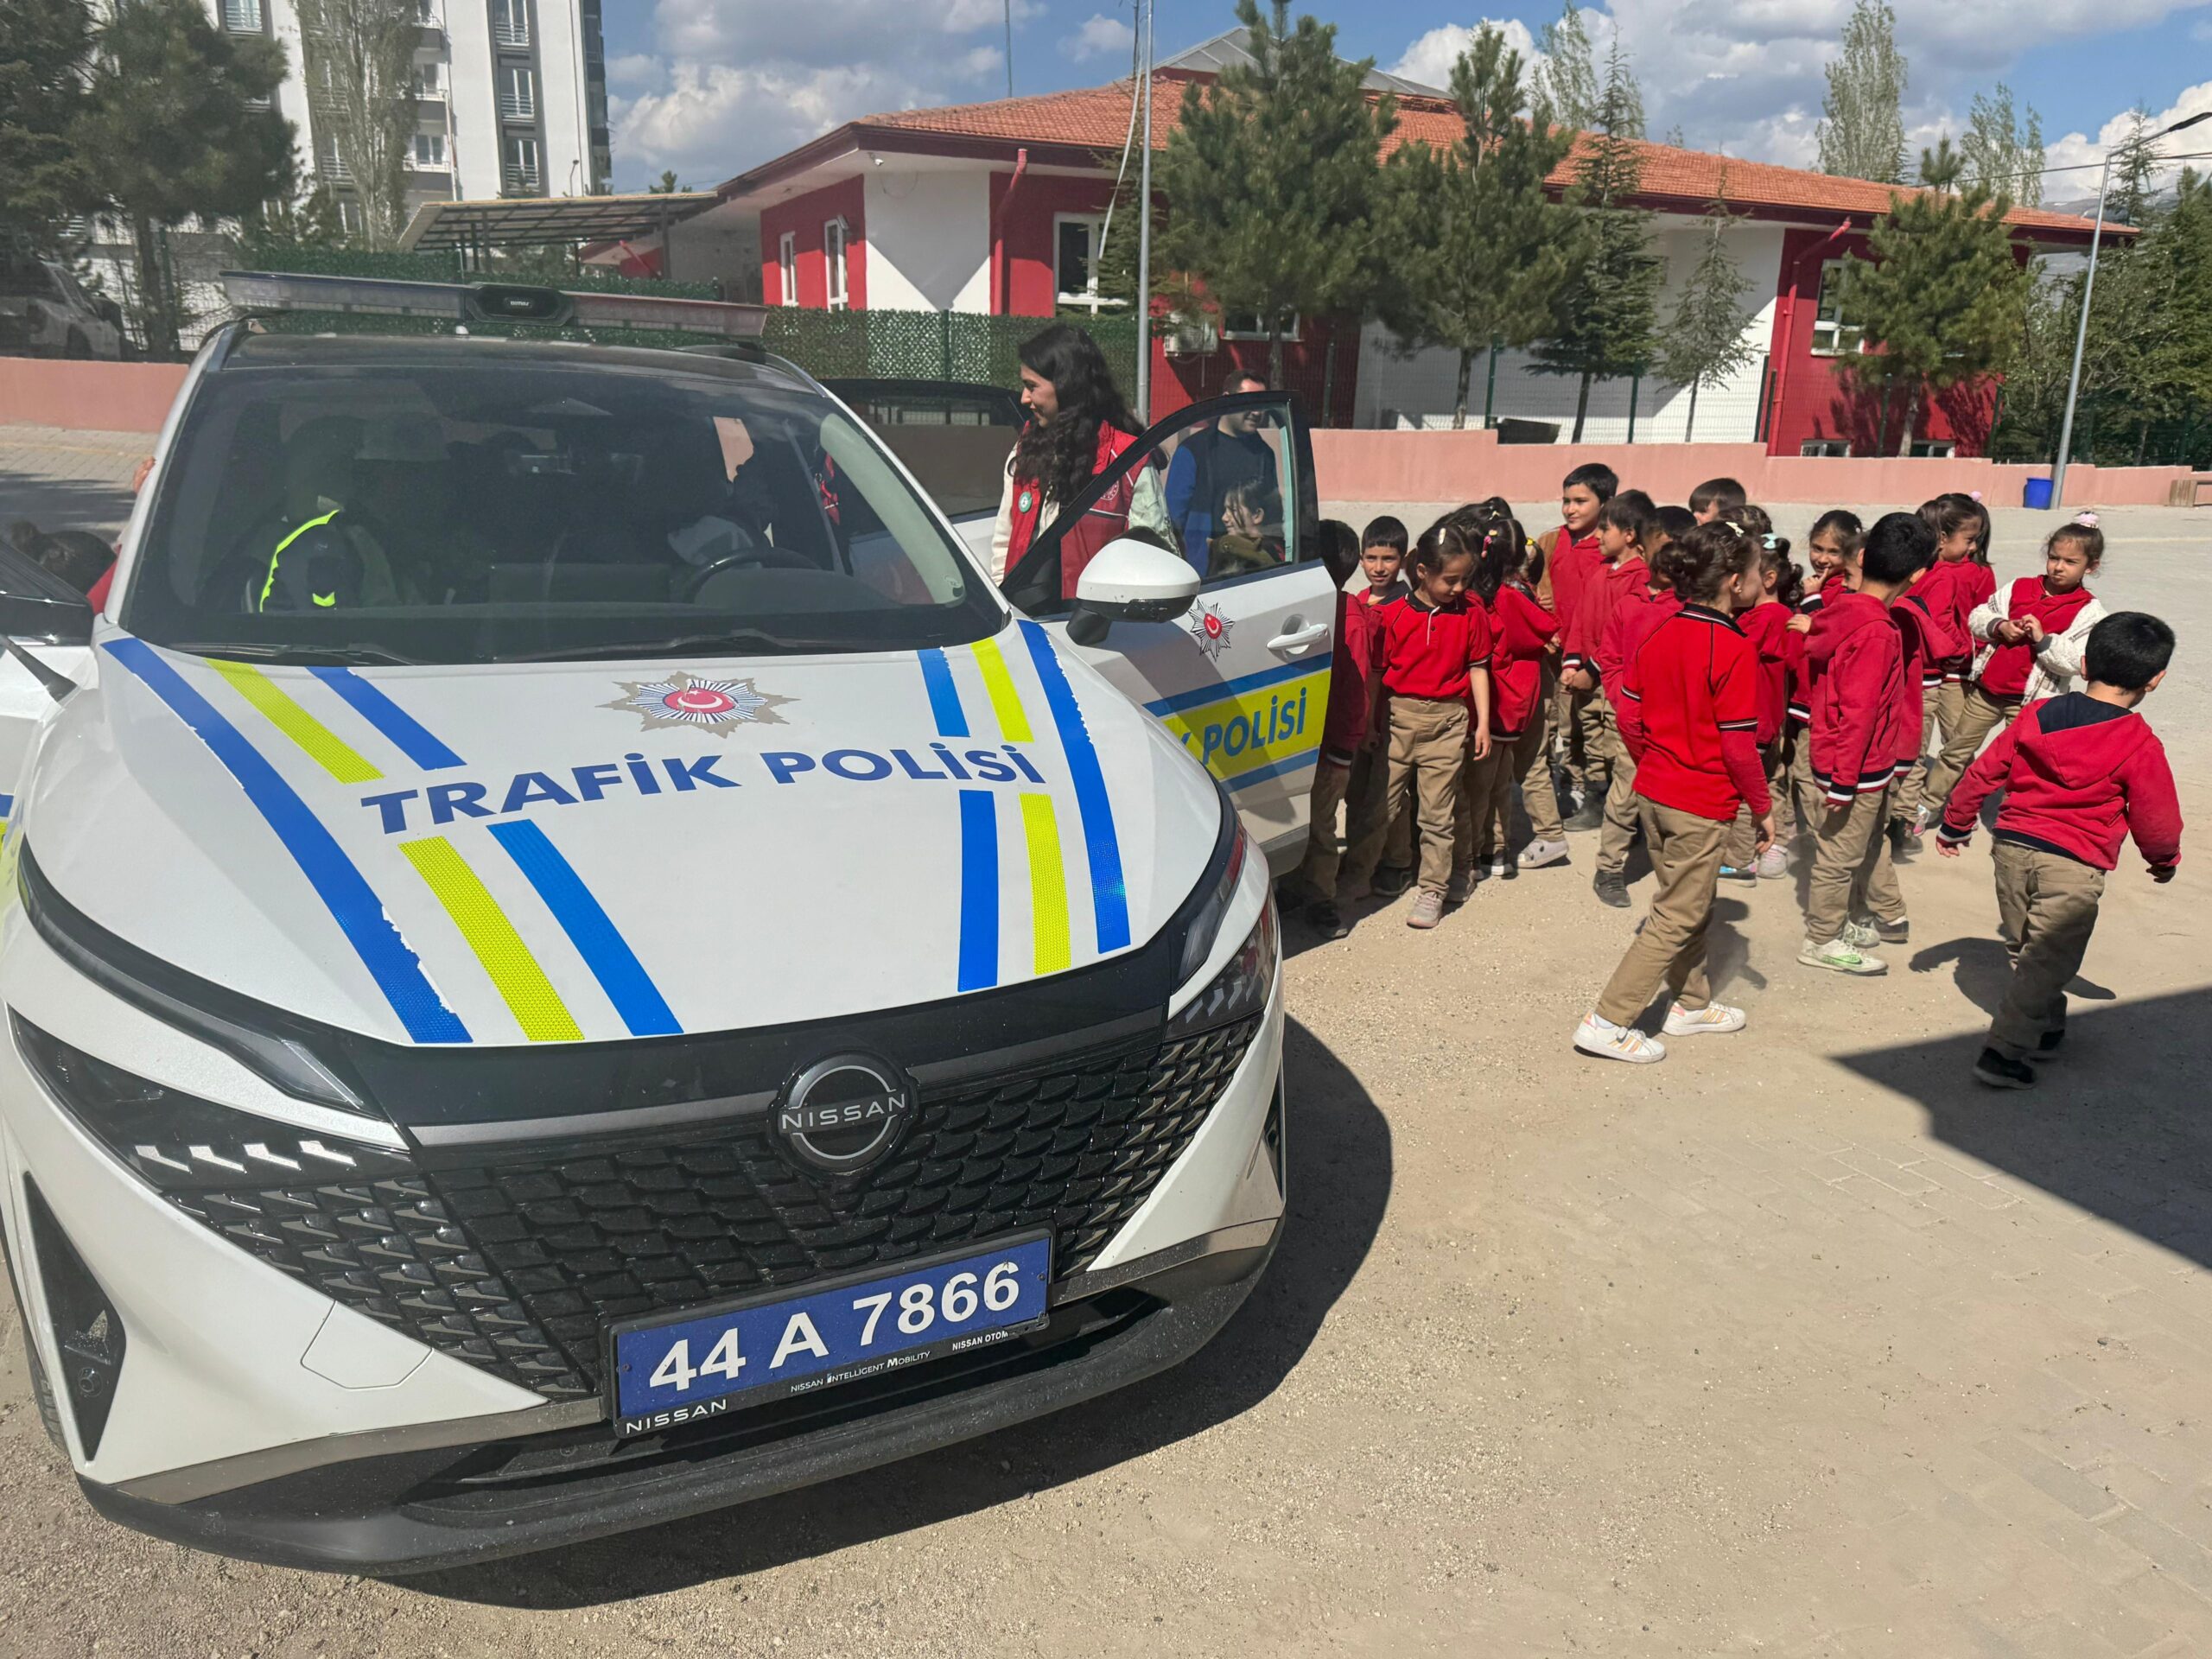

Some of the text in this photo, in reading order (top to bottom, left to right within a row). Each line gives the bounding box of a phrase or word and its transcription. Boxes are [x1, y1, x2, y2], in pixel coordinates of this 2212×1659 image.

[1202, 687, 1306, 766] POLİSİ
[361, 742, 1046, 834] TRAFİK POLİSİ
[782, 1093, 906, 1129] NISSAN
[649, 1262, 1020, 1392] 44 A 7866
[951, 1335, 983, 1351] NISSAN
[791, 1351, 931, 1393] NISSAN INTELLIGENT MOBILITY
[626, 1398, 728, 1434] NISSAN
